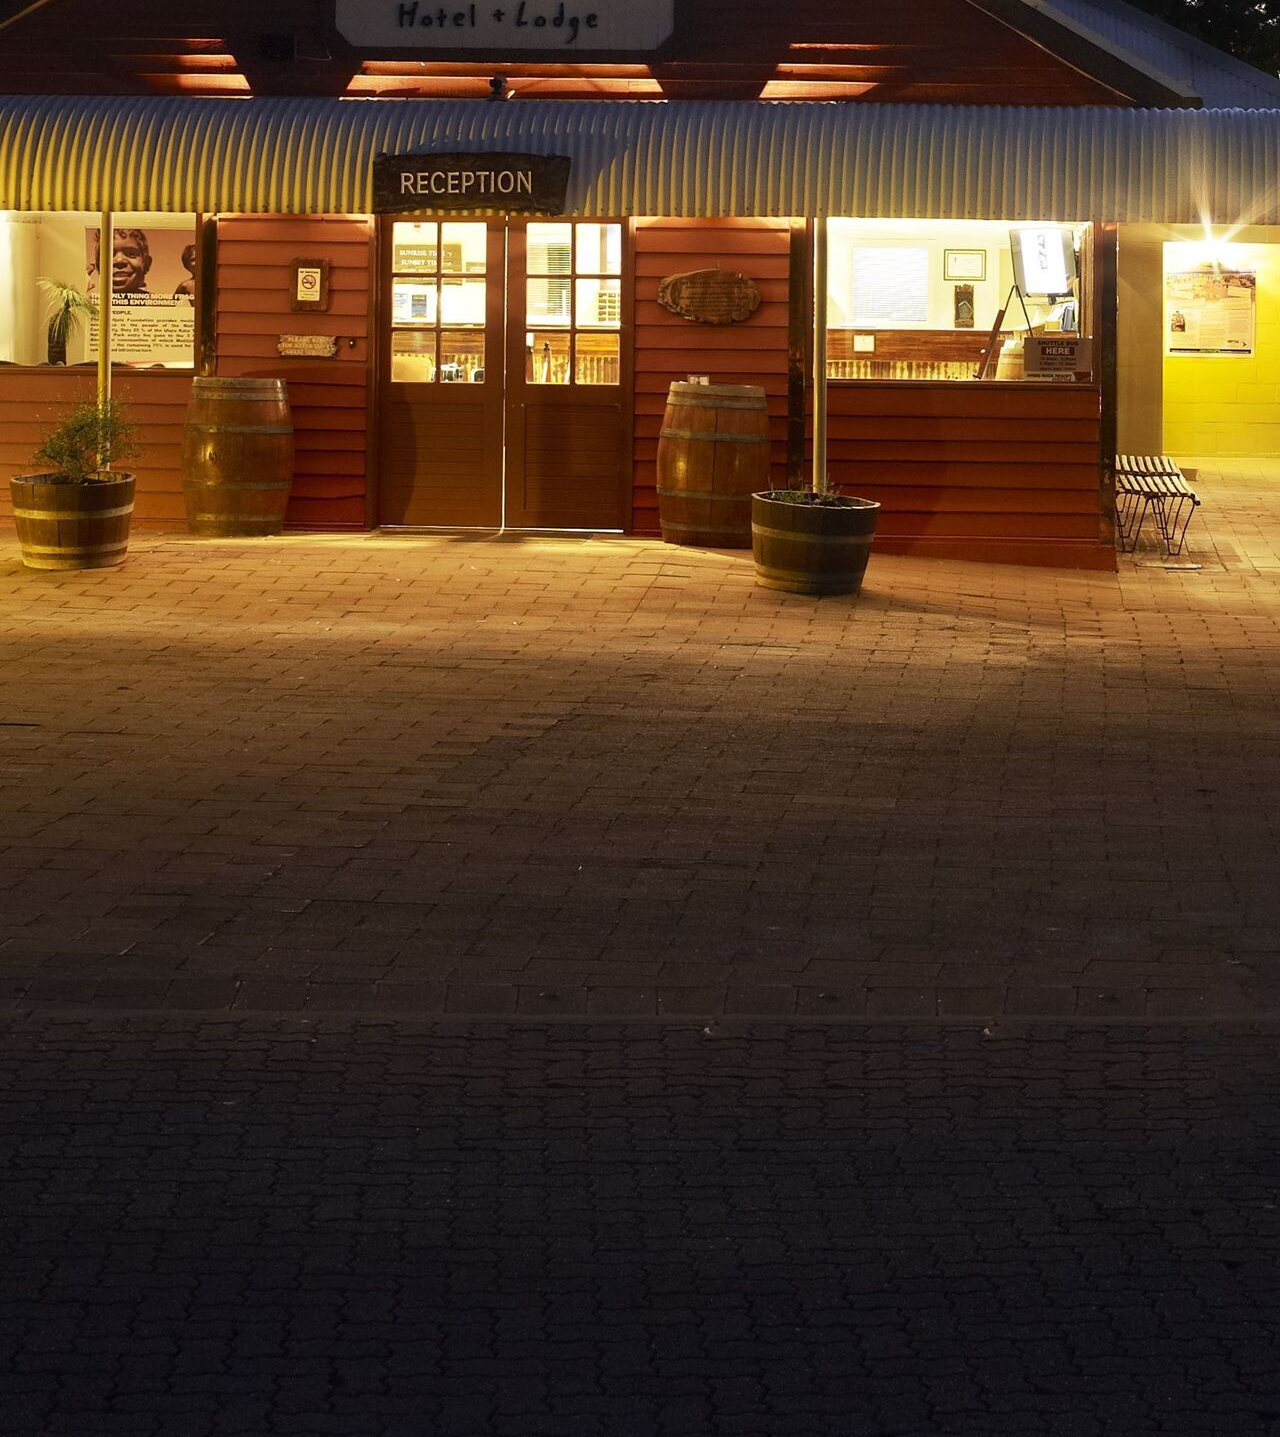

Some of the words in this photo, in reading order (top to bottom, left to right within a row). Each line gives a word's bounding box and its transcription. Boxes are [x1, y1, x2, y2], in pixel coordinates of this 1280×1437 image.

[397, 1, 475, 28] Hotel
[515, 1, 598, 44] Lodge
[400, 170, 532, 194] RECEPTION
[1046, 347, 1070, 355] HERE
